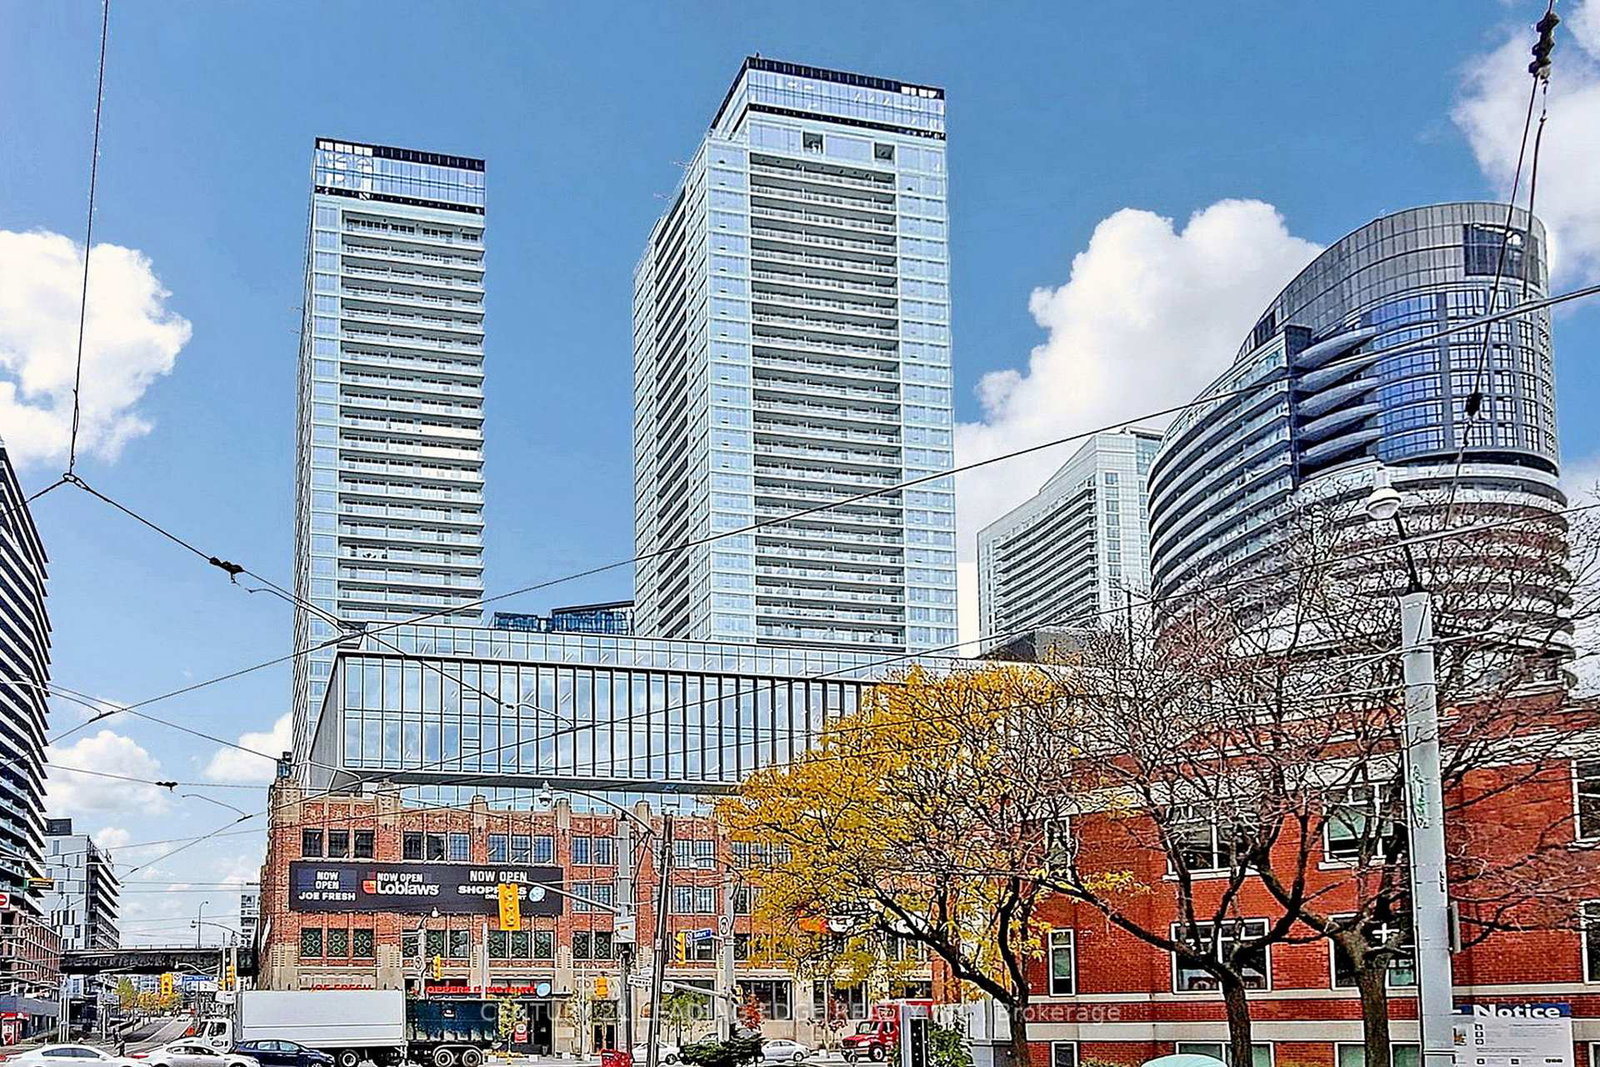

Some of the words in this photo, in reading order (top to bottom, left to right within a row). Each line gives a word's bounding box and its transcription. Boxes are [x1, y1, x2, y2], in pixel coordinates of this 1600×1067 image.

[316, 871, 339, 880] NOW
[377, 872, 399, 882] NOW
[400, 873, 423, 883] OPEN
[469, 870, 496, 882] NOW
[499, 871, 528, 882] OPEN
[315, 880, 340, 890] OPEN
[377, 880, 440, 896] Loblaws
[458, 885, 528, 895] SHOPPS
[298, 891, 320, 900] JOE
[322, 892, 356, 901] FRESH
[1473, 1003, 1561, 1019] Notice
